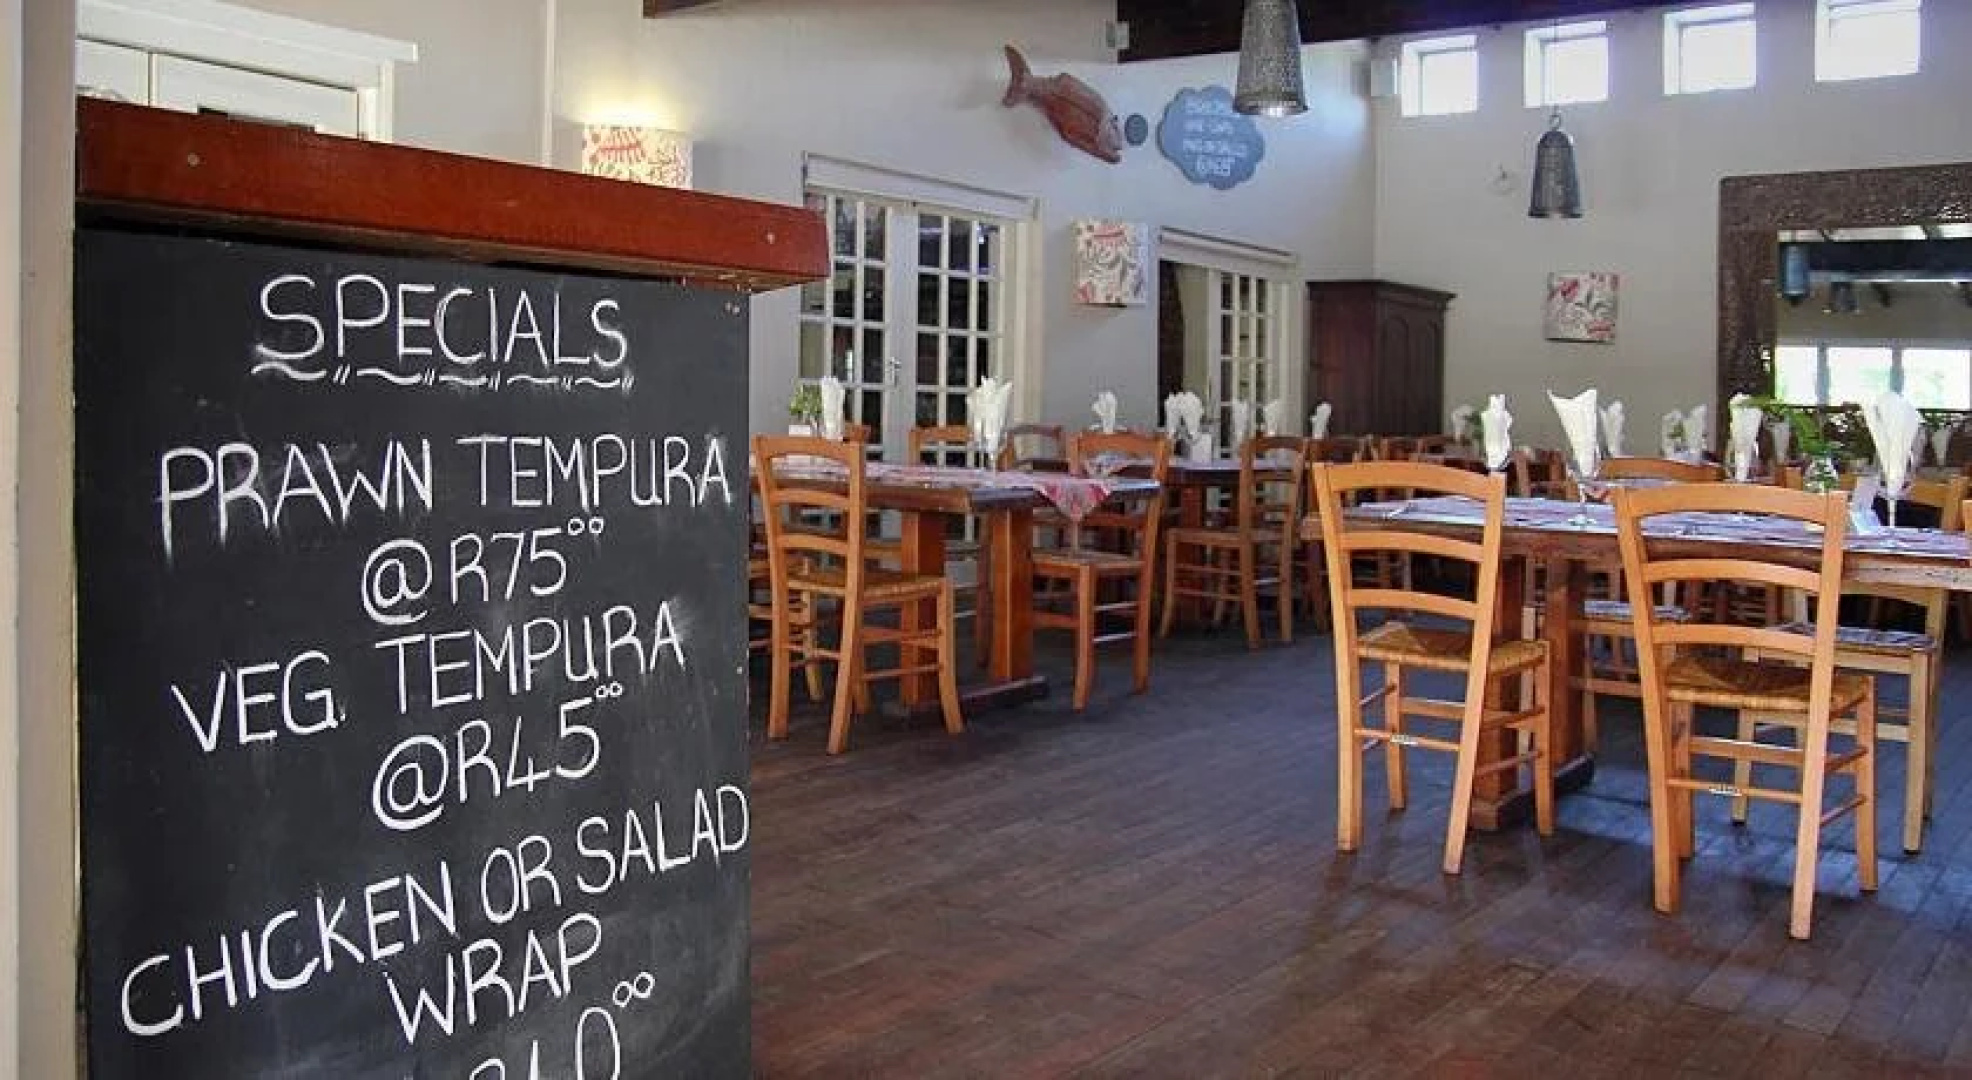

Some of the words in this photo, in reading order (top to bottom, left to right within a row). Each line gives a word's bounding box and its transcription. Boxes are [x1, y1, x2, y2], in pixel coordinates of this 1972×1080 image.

[256, 275, 628, 368] SPECIALS
[160, 438, 433, 560] PRAWN
[457, 434, 732, 509] TEMPURA
[375, 601, 685, 714] TEMPURA
[122, 861, 455, 1035] CHICKEN
[481, 836, 562, 923] OR
[577, 785, 749, 892] SALAD
[387, 913, 602, 1043] WRAP
